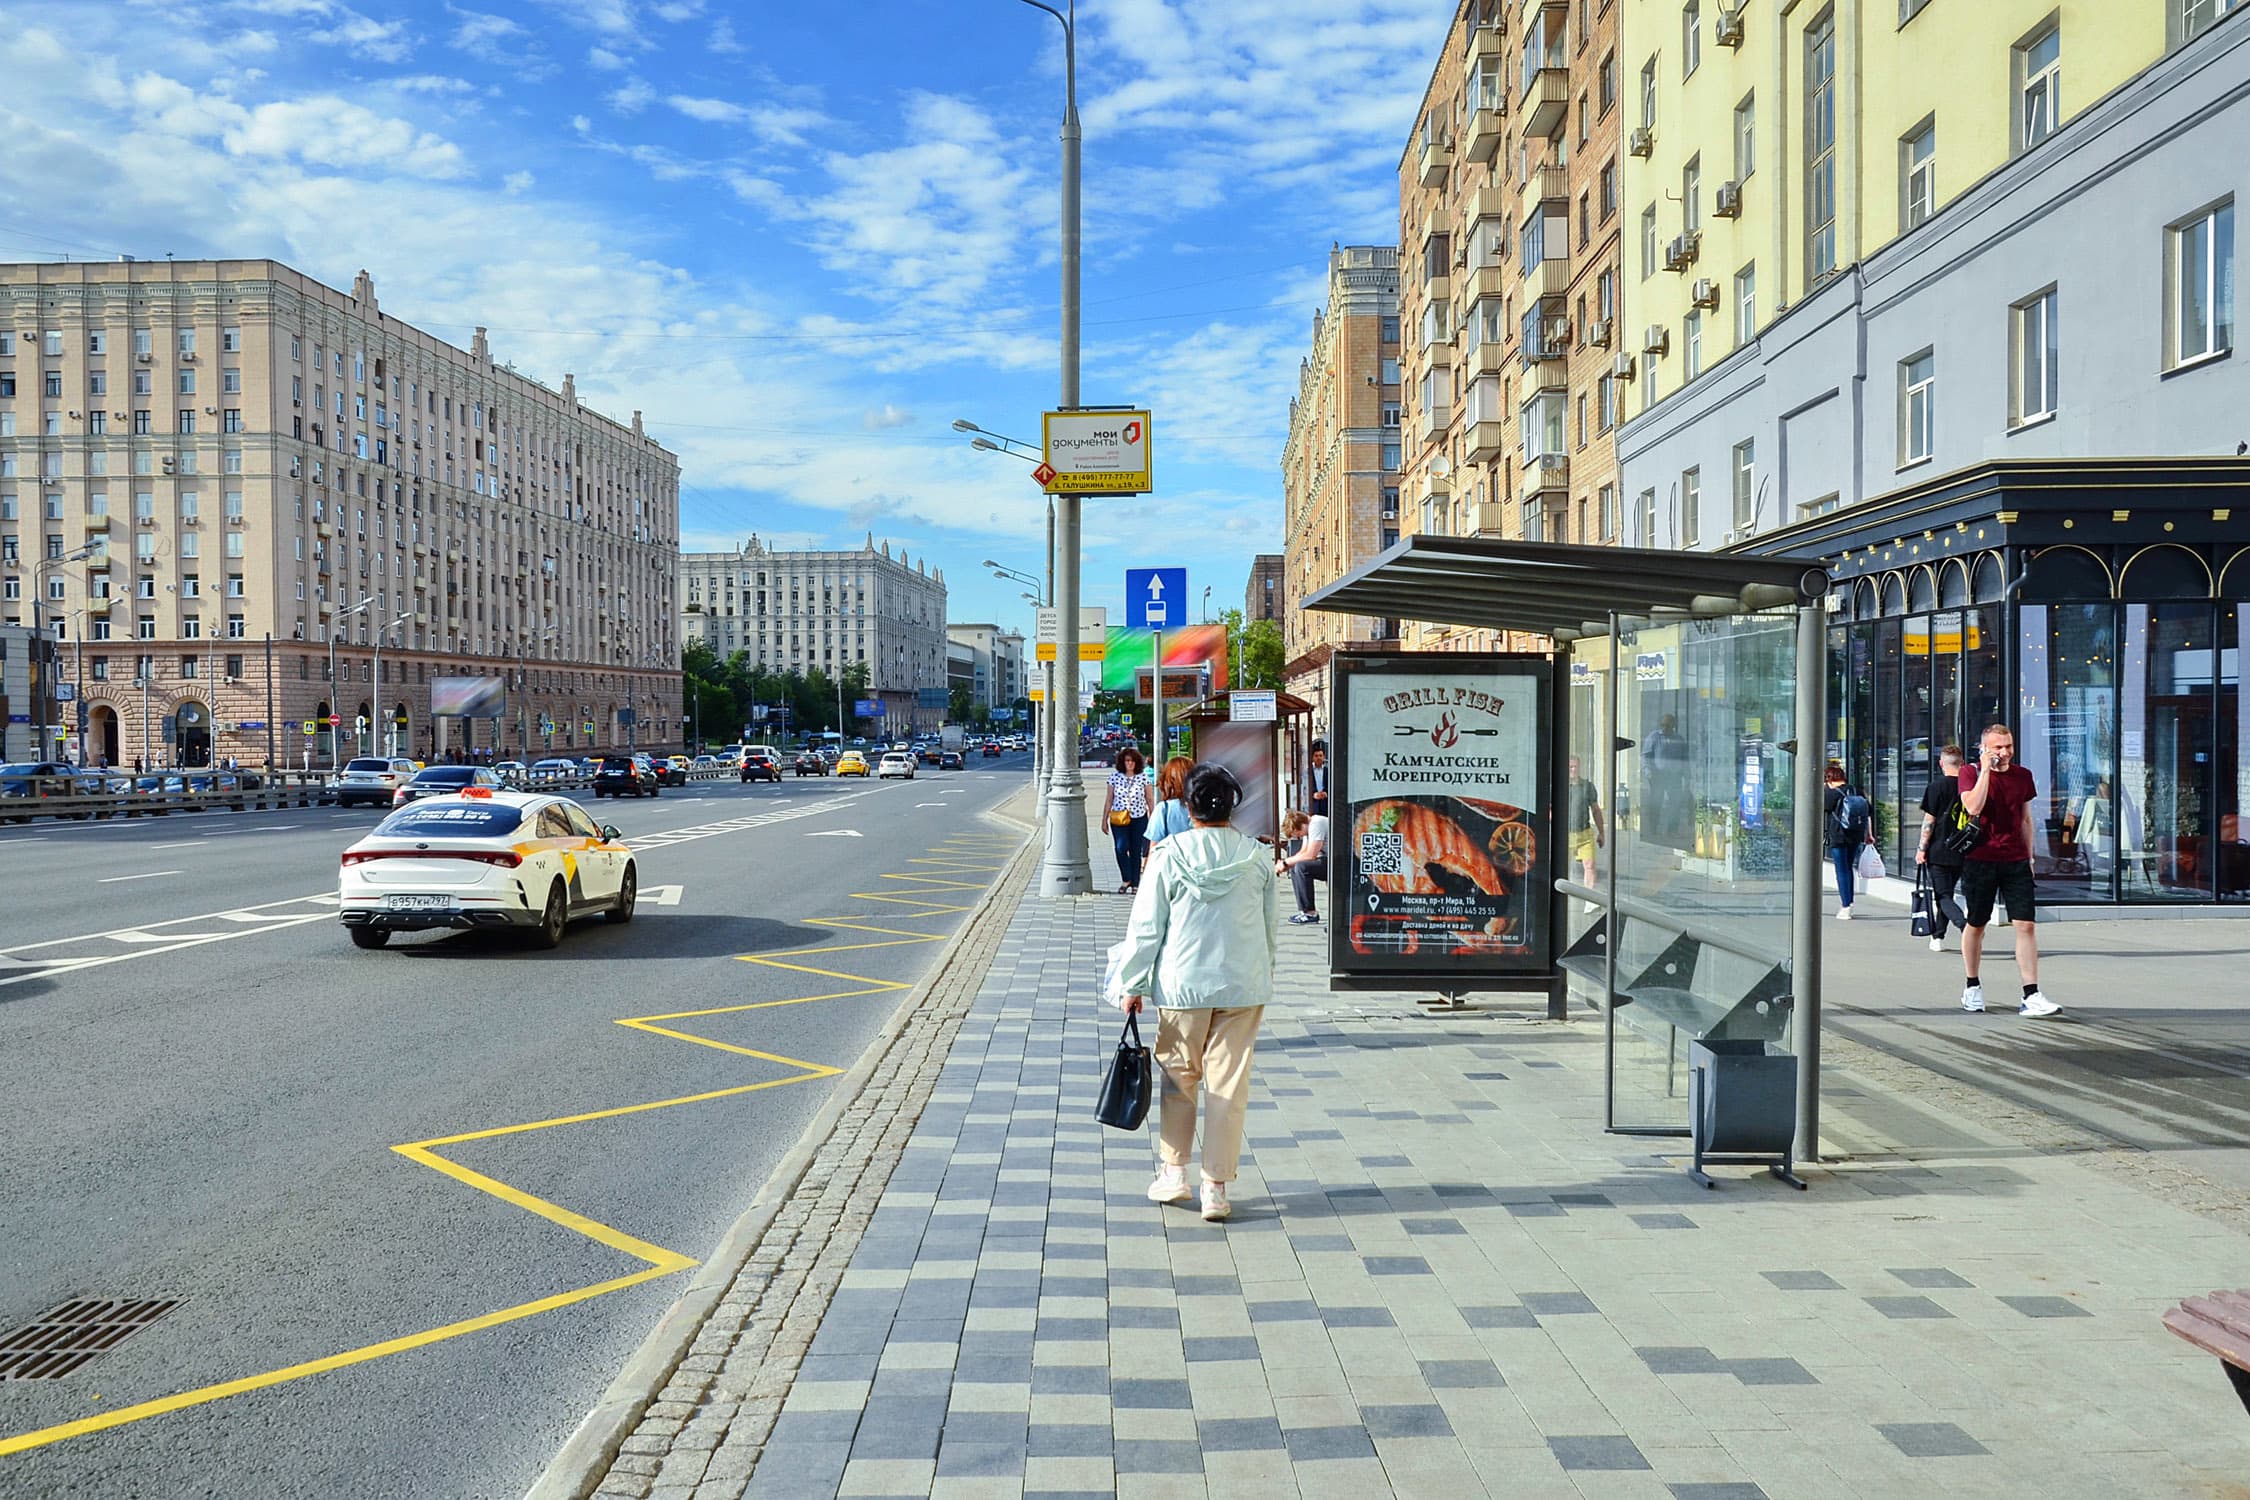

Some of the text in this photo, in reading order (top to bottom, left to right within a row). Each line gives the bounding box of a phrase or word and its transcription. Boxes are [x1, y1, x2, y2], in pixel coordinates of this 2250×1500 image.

[1093, 431, 1118, 439] мои
[1052, 438, 1118, 449] документы
[1383, 687, 1505, 717] GRILL FISH
[1360, 875, 1368, 884] 0+
[1402, 895, 1476, 906] Москва, пр-т Мира, 116
[1446, 906, 1463, 915] (495)
[1464, 907, 1477, 915] 445
[1478, 907, 1487, 915] 25
[1488, 907, 1496, 915] 55
[1402, 921, 1428, 929] Доставка
[1429, 921, 1446, 929] домой
[1460, 923, 1474, 931] дачу
